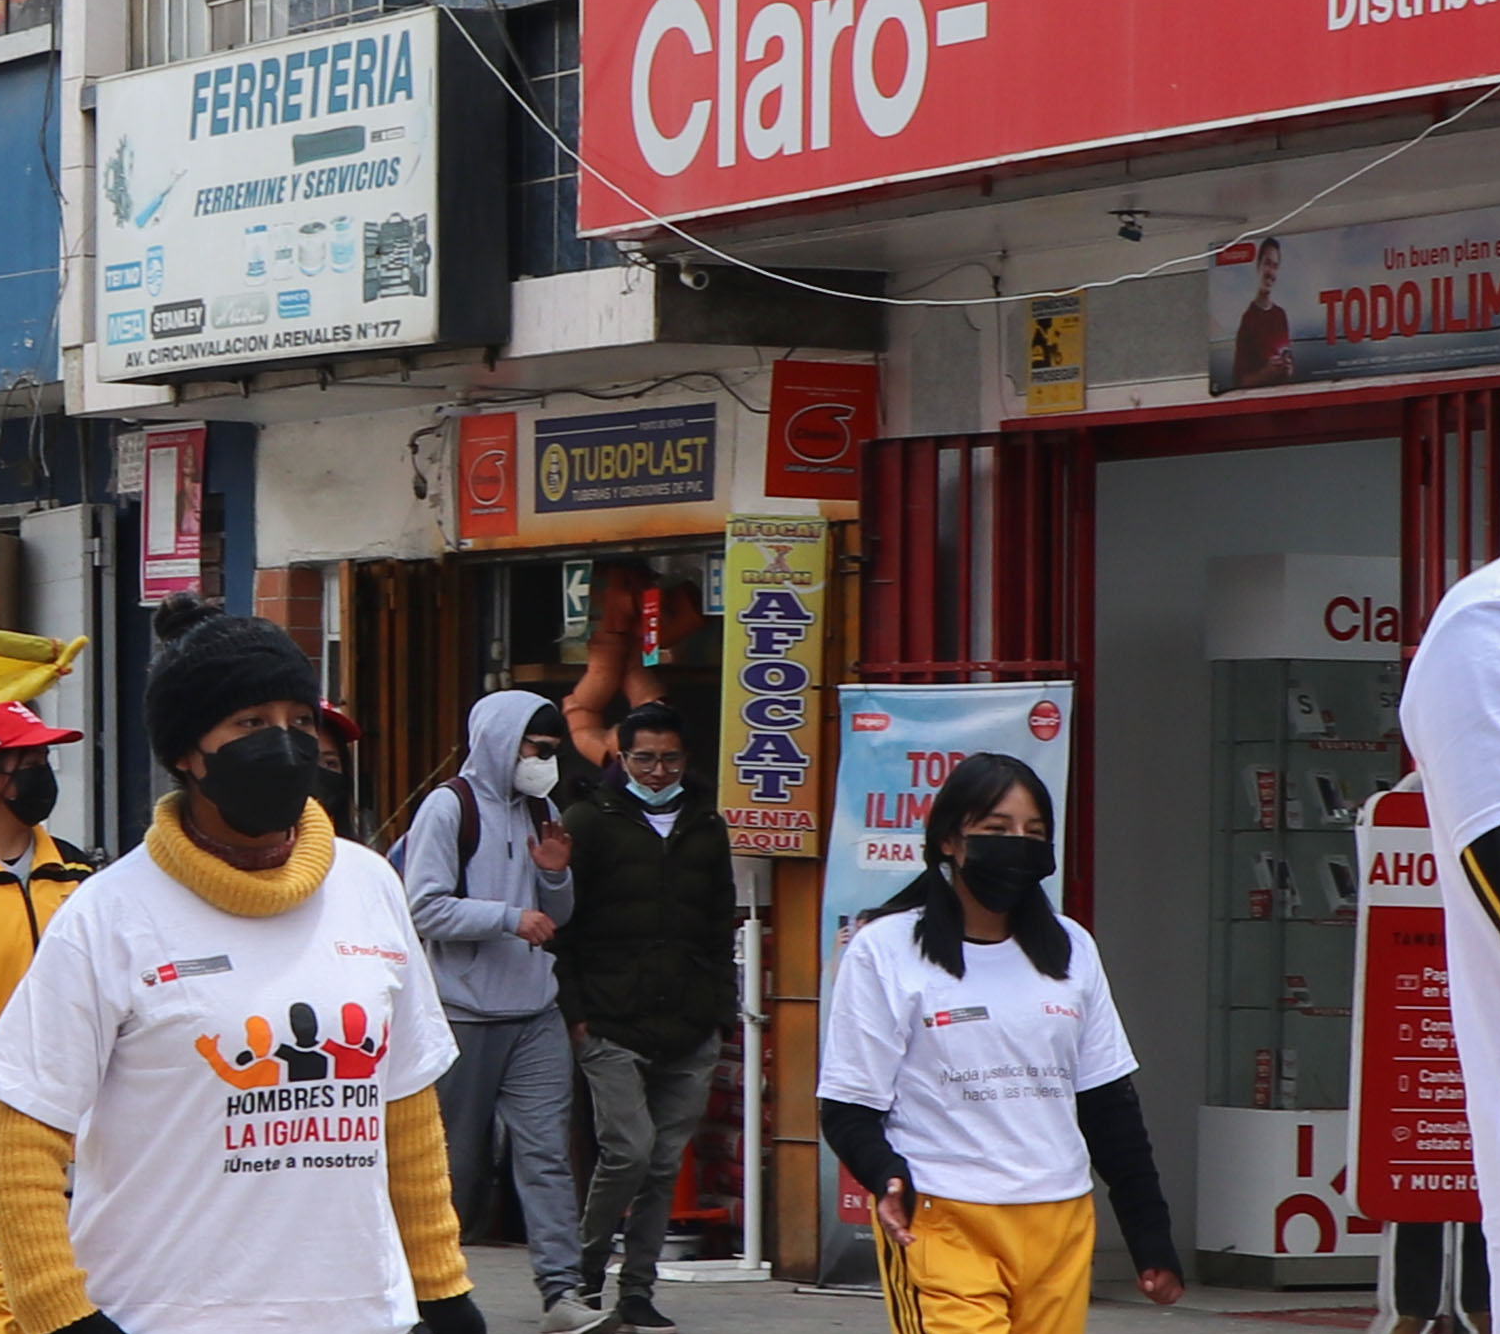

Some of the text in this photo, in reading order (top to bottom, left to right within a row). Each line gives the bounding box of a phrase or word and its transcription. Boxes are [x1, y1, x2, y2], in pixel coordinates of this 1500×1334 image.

[189, 29, 413, 141] FERRETERIA
[194, 156, 402, 217] FERREMINE Y SERVICIOS
[1384, 245, 1404, 270] Un
[1408, 241, 1450, 268] buen
[1455, 238, 1491, 266] plan
[152, 308, 203, 335] STANLEY
[1319, 278, 1423, 345] TODO
[125, 350, 144, 368] AV.
[148, 336, 270, 365] CIRCUNVALACION
[271, 323, 353, 351] ARENALES
[570, 436, 709, 482] TUBOPLAST
[733, 587, 816, 803] AFOCAT
[724, 808, 817, 830] VENTA
[866, 843, 914, 862] PARA
[1420, 1034, 1448, 1049] chip
[226, 1084, 379, 1118] HOMBRES POR
[963, 1086, 1020, 1102] hacia las
[1419, 1086, 1465, 1102] tu plan
[224, 1116, 379, 1151] LA IGUALDAD
[1417, 1137, 1461, 1151] estado
[223, 1152, 281, 1175] ¡Únete
[286, 1155, 297, 1168] a
[1391, 1174, 1402, 1190] Y
